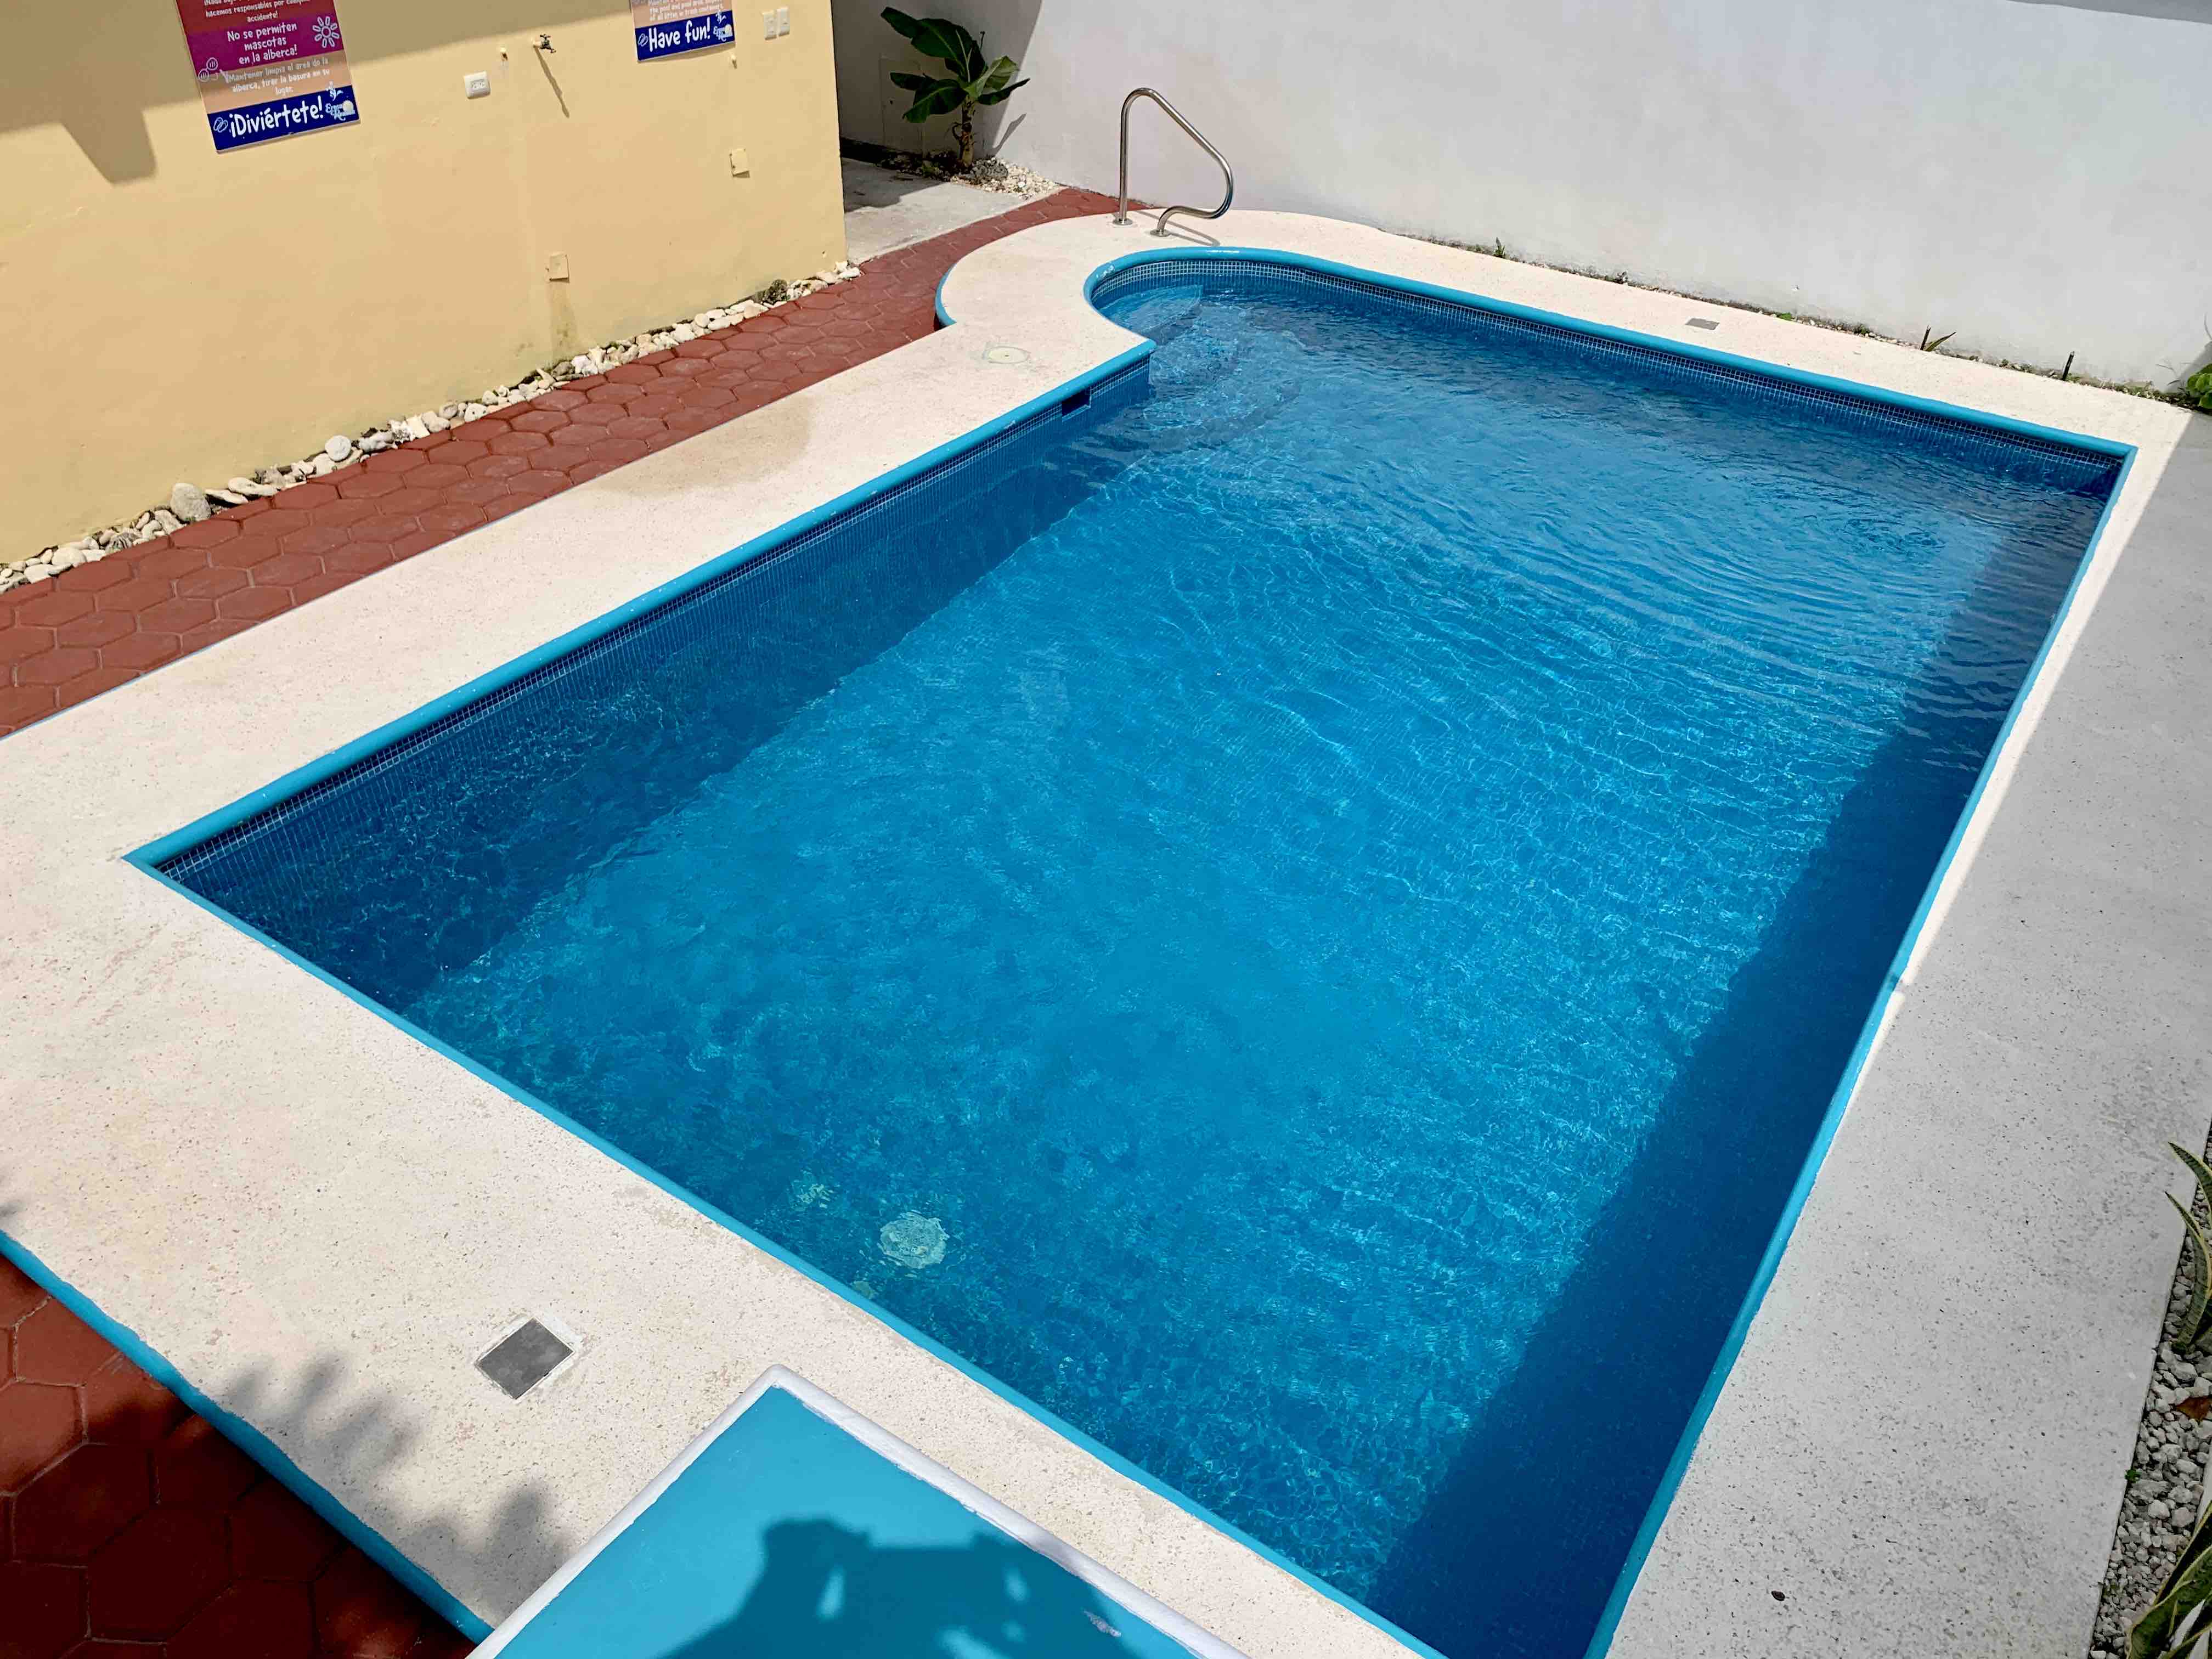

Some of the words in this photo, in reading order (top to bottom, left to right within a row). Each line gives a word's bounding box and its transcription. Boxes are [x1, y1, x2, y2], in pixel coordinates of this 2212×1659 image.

[234, 2, 273, 13] responsables
[227, 30, 240, 42] No
[243, 30, 253, 40] se
[256, 22, 297, 40] permiten
[648, 27, 681, 52] Have
[685, 17, 710, 43] fun!
[244, 36, 286, 51] mascotas
[239, 56, 250, 65] en
[252, 52, 260, 63] la
[263, 44, 297, 60] alberca!
[229, 95, 323, 138] ¡Diviértete!
